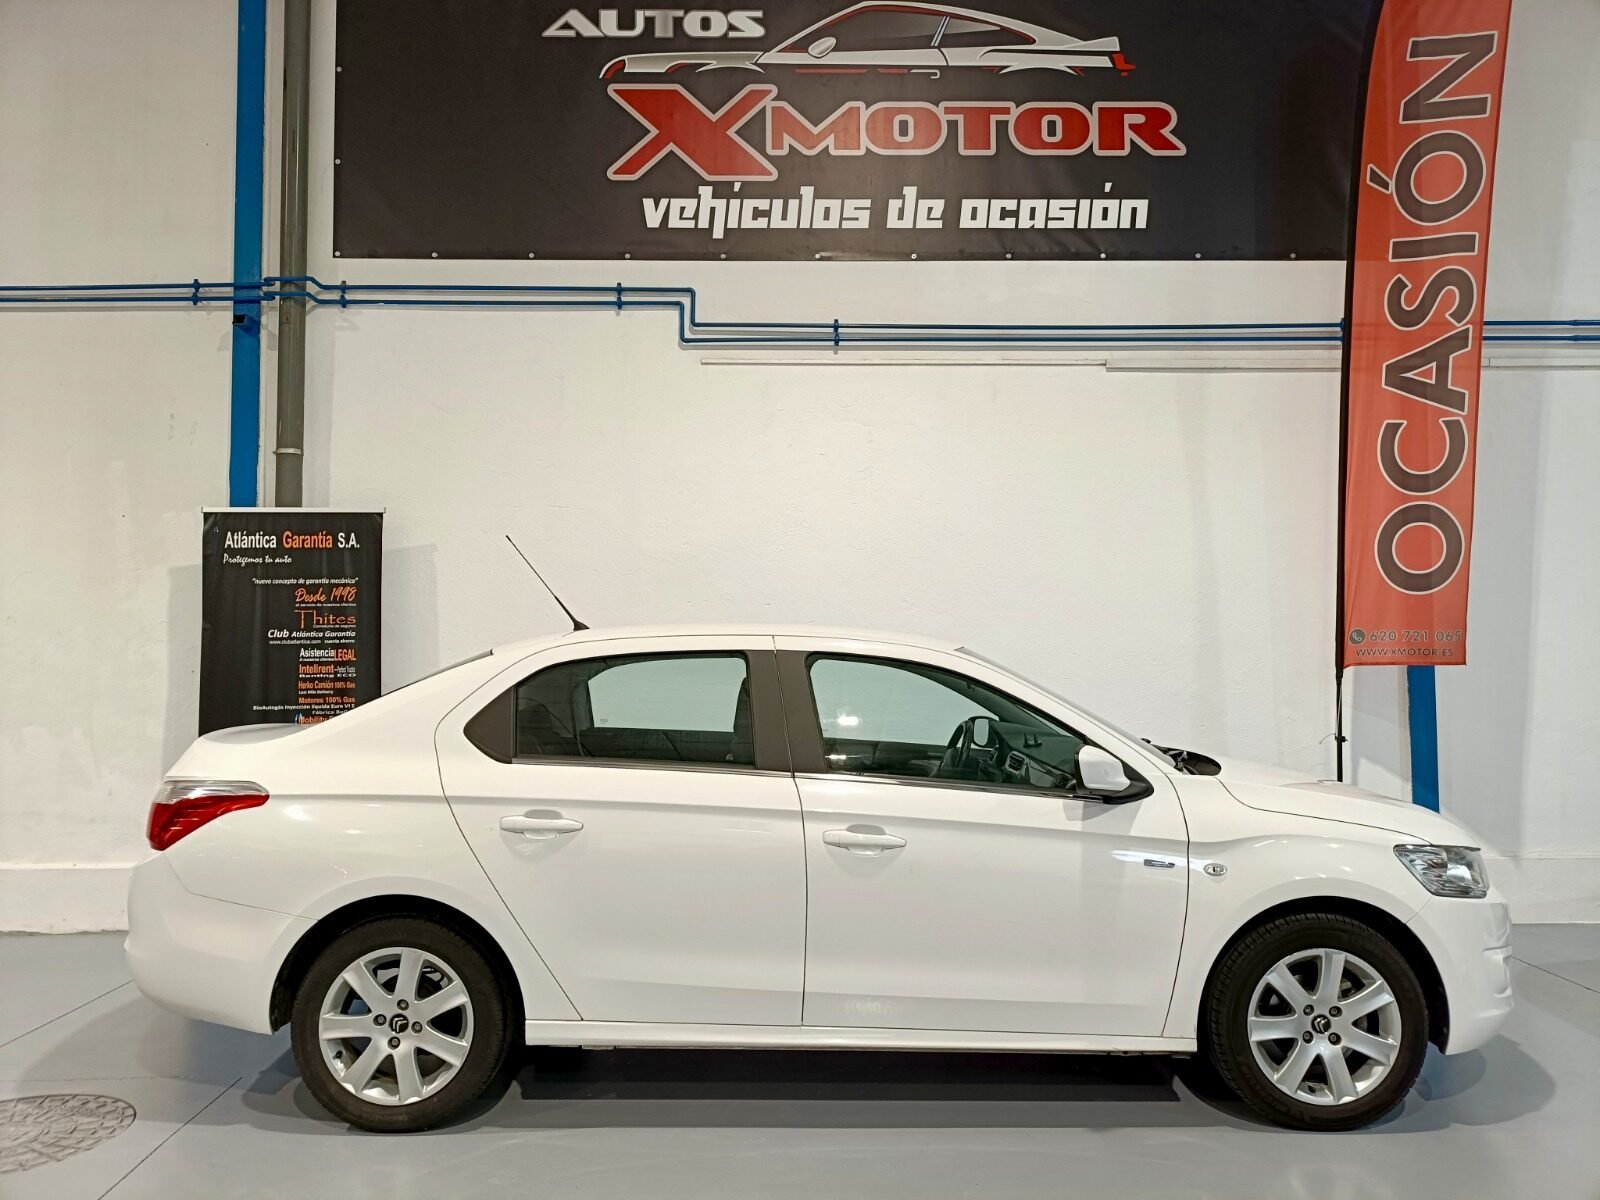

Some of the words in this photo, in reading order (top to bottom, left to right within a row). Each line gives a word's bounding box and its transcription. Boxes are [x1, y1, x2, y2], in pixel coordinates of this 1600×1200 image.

[541, 8, 766, 38] AUTOS
[606, 83, 1187, 182] XMOTOR
[642, 182, 871, 239] vehículos
[885, 186, 944, 230] de
[959, 182, 1149, 230] ocasión
[1367, 30, 1498, 595] OCASIÓN
[224, 531, 277, 548] Atlántica
[282, 530, 333, 548] Garantía
[337, 532, 360, 548] S.A.
[223, 552, 263, 567] Protegemos
[264, 555, 273, 563] tu
[274, 555, 292, 563] auto
[294, 587, 327, 602] Desde
[330, 586, 357, 601] 1998
[294, 609, 356, 629] Thites
[267, 629, 290, 638] Club
[291, 630, 323, 638] Atlántica
[1369, 630, 1397, 642] 620
[1403, 630, 1429, 642] 721
[1434, 629, 1462, 642] 065
[1355, 648, 1454, 656] WWW.XMOTOR.ES
